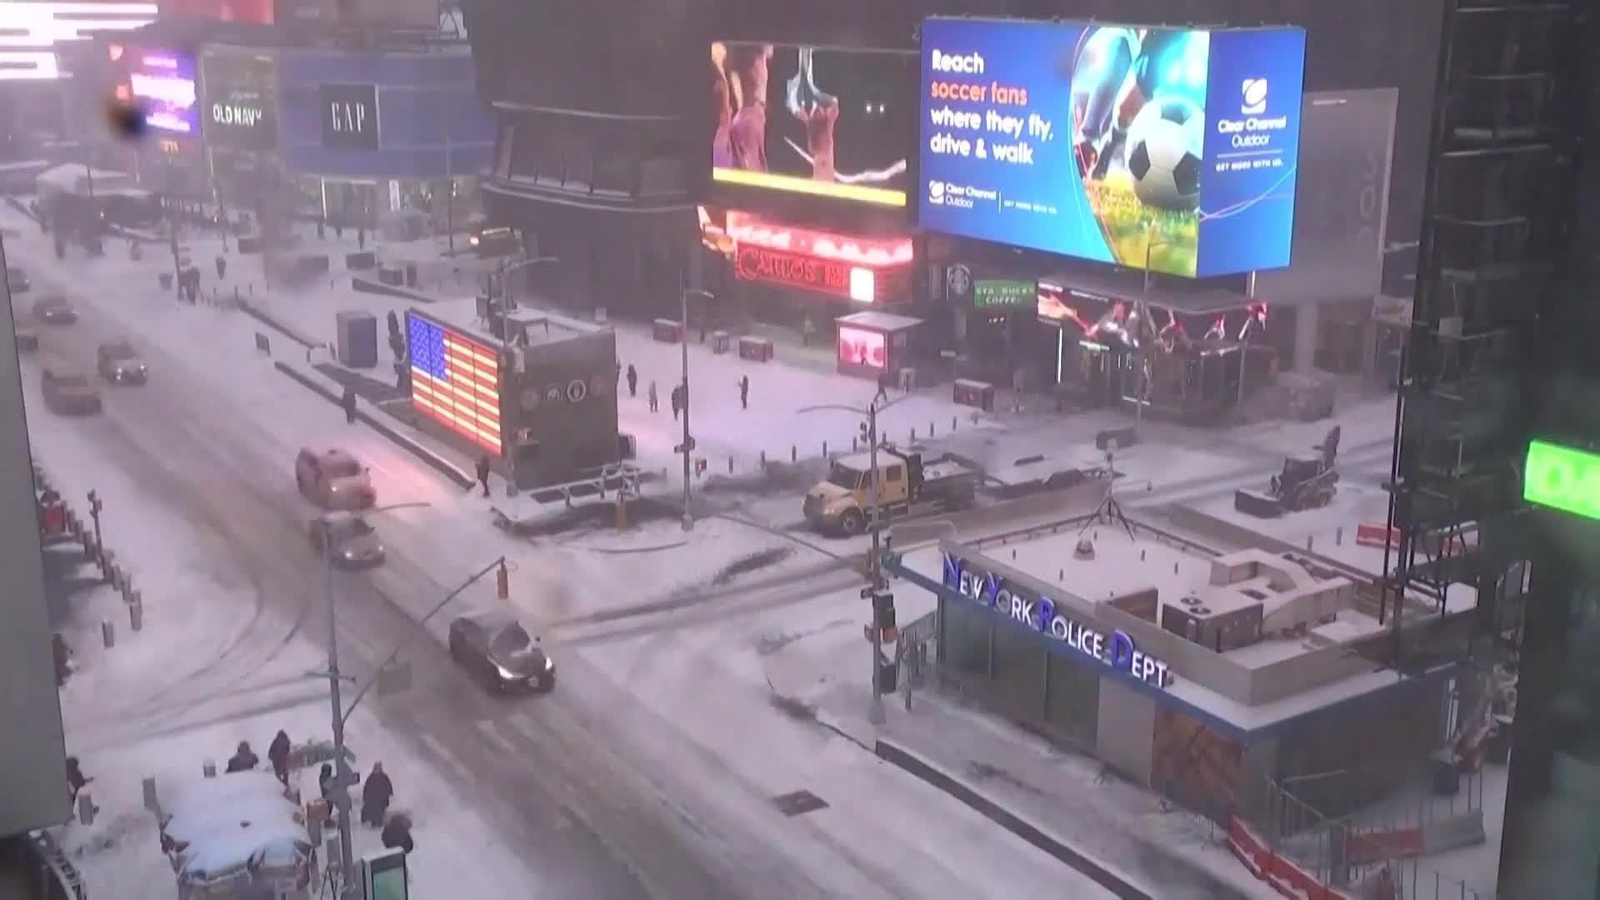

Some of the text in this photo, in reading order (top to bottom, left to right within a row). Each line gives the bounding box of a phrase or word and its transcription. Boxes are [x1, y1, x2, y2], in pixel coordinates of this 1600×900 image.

[932, 49, 984, 74] Reach
[931, 81, 1028, 106] soccer fans
[213, 103, 233, 125] OLD
[234, 106, 262, 127] NAVY
[331, 102, 365, 132] GAP
[931, 105, 982, 130] where
[986, 109, 1024, 139] they
[1218, 115, 1287, 134] Clear Channel
[930, 132, 1034, 165] drive & walk
[1231, 133, 1270, 149] Outdoor
[943, 553, 984, 600] NEW
[986, 571, 1034, 625] YORK
[1040, 594, 1104, 660] POLICE
